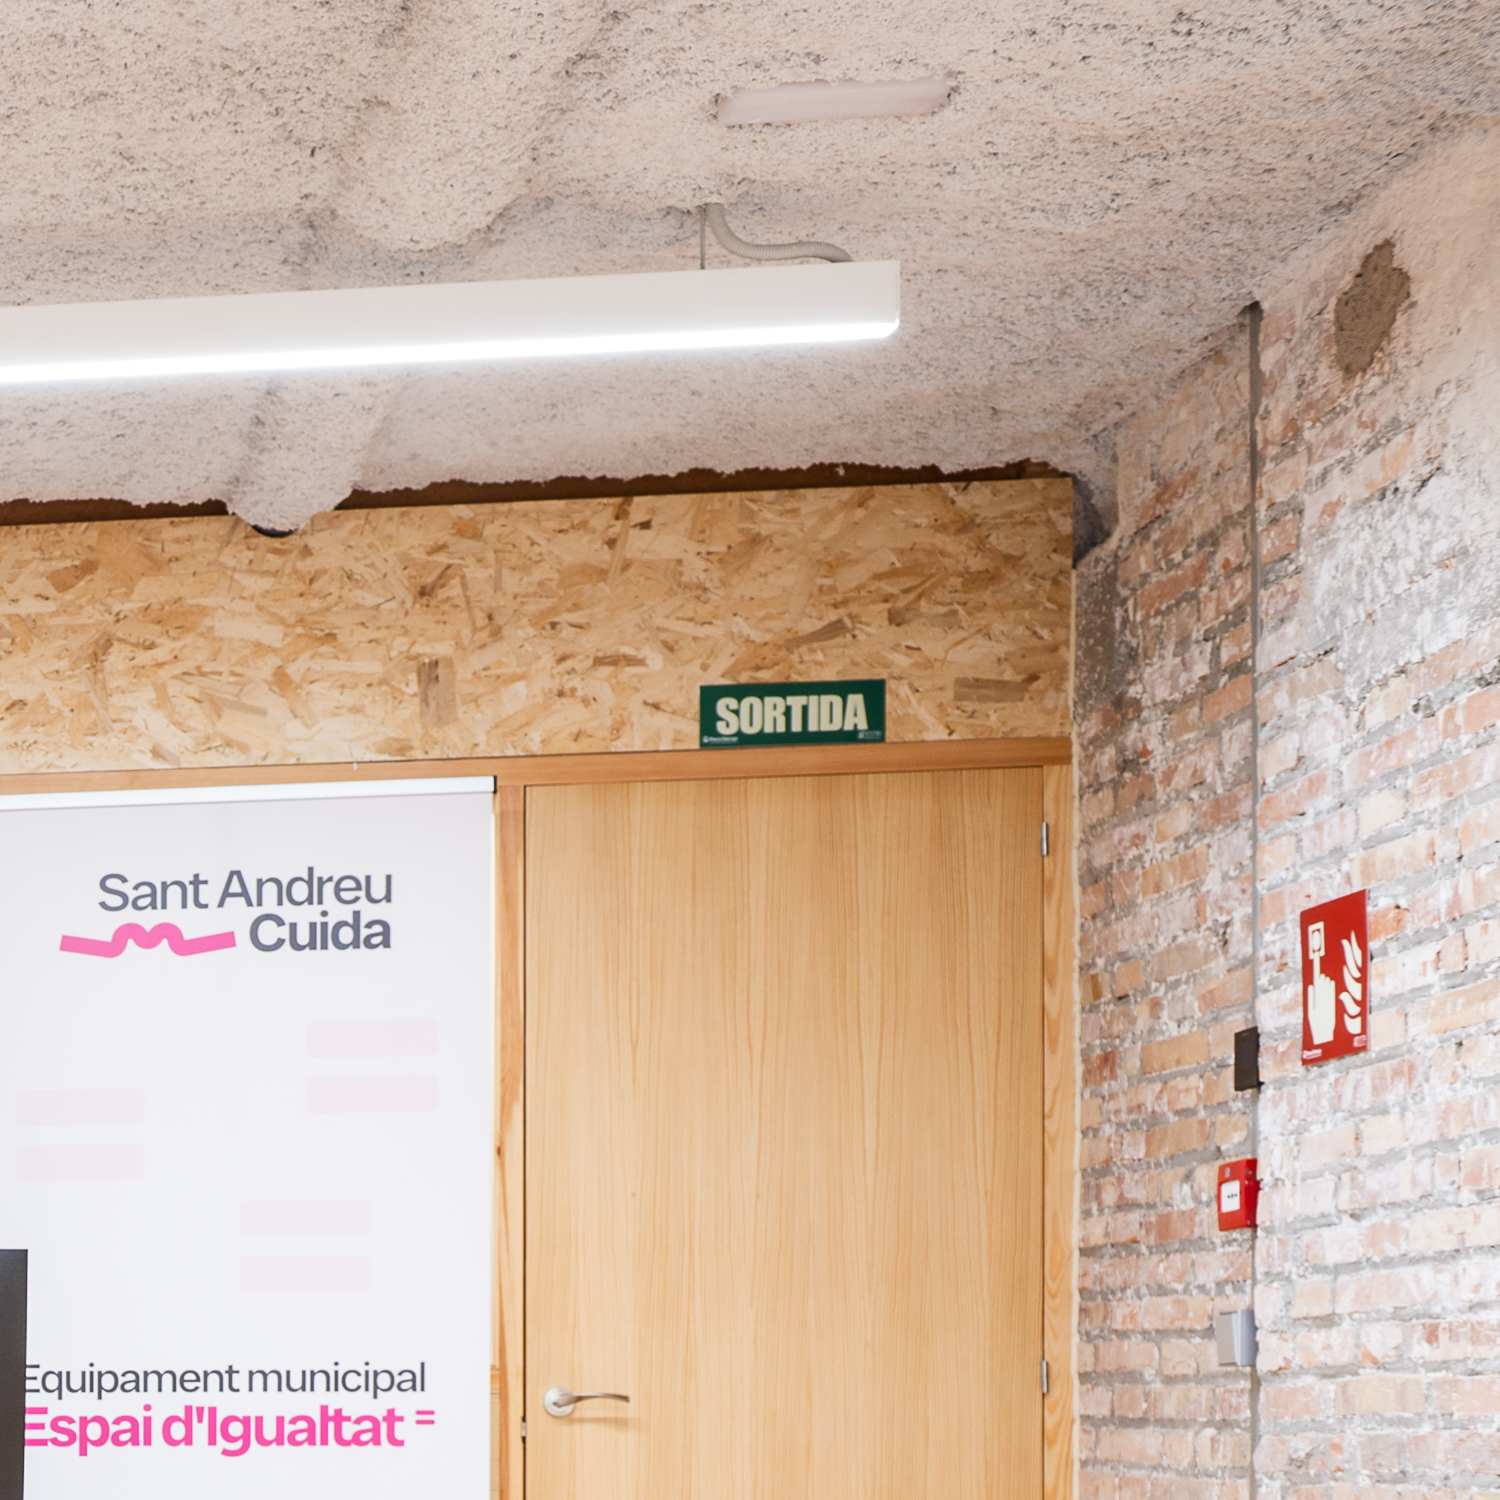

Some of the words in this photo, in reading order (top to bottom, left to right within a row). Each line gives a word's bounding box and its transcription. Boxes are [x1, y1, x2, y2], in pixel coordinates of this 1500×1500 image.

[716, 693, 868, 735] SORTIDA
[98, 872, 209, 912] Sant
[217, 866, 392, 908] Andreu
[250, 911, 392, 953] Cuida
[26, 1362, 241, 1400] Equipament
[248, 1361, 426, 1399] municipal
[25, 1404, 153, 1457] Espai
[161, 1404, 405, 1458] d'Igualtat
